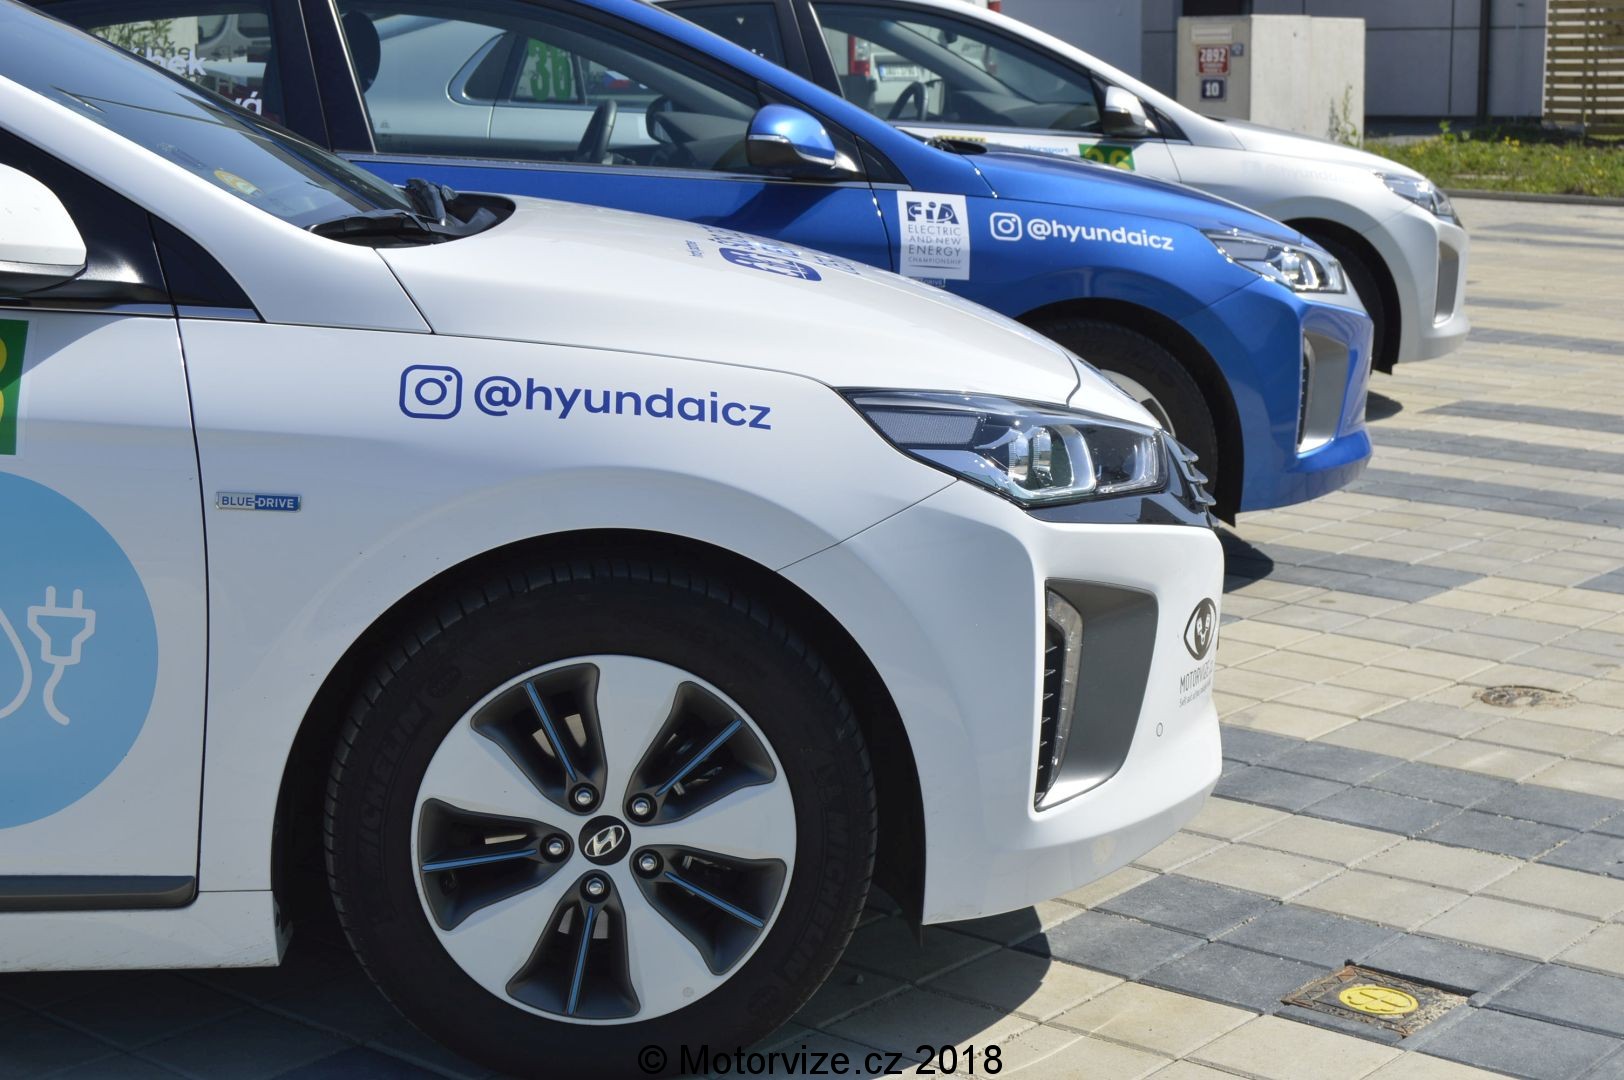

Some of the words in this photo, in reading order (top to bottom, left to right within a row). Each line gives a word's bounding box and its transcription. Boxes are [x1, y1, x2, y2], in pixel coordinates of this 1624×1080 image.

[1200, 48, 1226, 63] 2892
[1205, 82, 1220, 97] 10
[907, 224, 961, 236] ELECTRIC
[1026, 217, 1175, 251] @hyundaicz
[908, 235, 934, 243] AND
[935, 237, 962, 245] NEW
[908, 245, 962, 257] ENERGY
[907, 256, 962, 265] CHAMPIONSHIP
[474, 375, 772, 430] @hyundaicz
